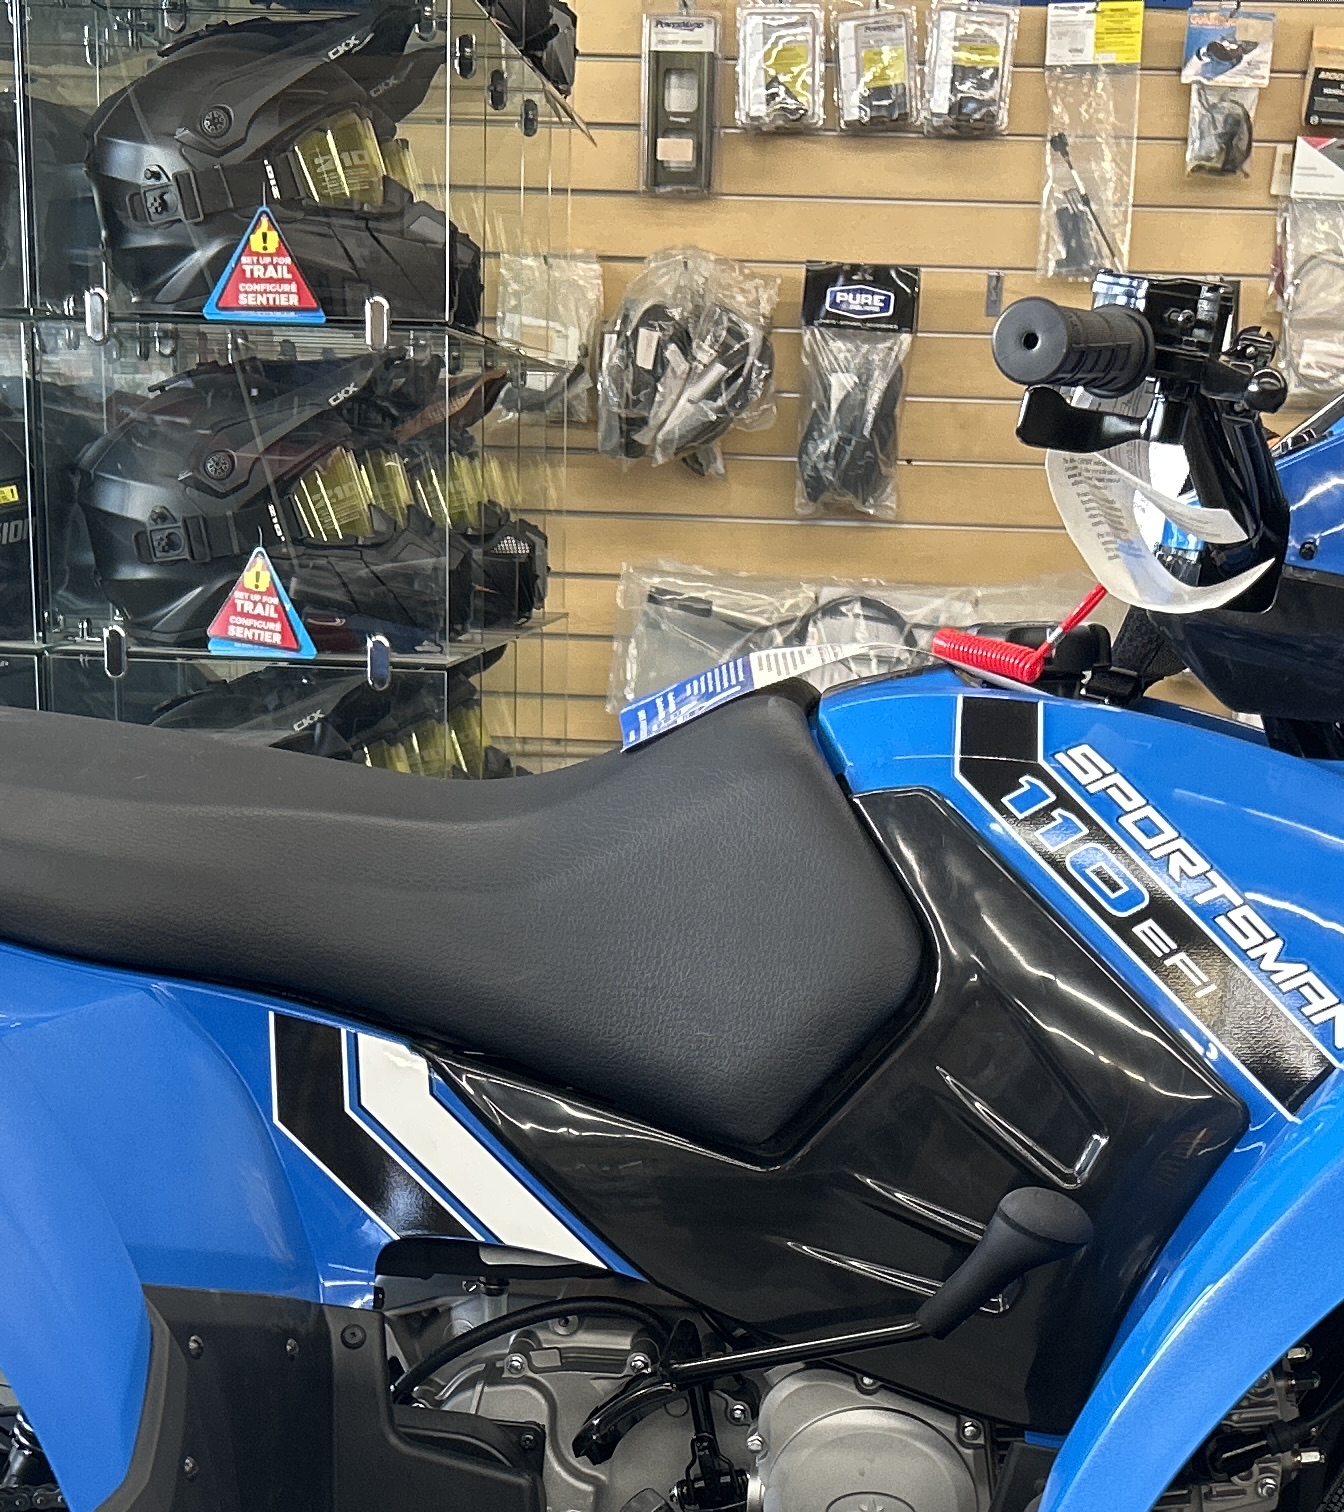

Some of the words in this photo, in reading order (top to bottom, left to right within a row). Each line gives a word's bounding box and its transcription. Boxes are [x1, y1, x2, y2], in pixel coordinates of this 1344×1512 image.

[328, 34, 360, 60] CKX
[241, 256, 258, 264] SET
[259, 256, 271, 264] UP
[273, 256, 291, 265] FOR
[243, 265, 293, 279] TRAIL
[238, 282, 297, 293] CONFIGURÉ
[238, 294, 299, 306] SENTIER
[836, 291, 886, 307] PURE
[329, 381, 359, 407] CKX
[235, 599, 279, 618] TRAIL
[228, 626, 282, 645] SENTIER
[1000, 774, 1150, 918] 110
[1131, 918, 1218, 999] EFI
